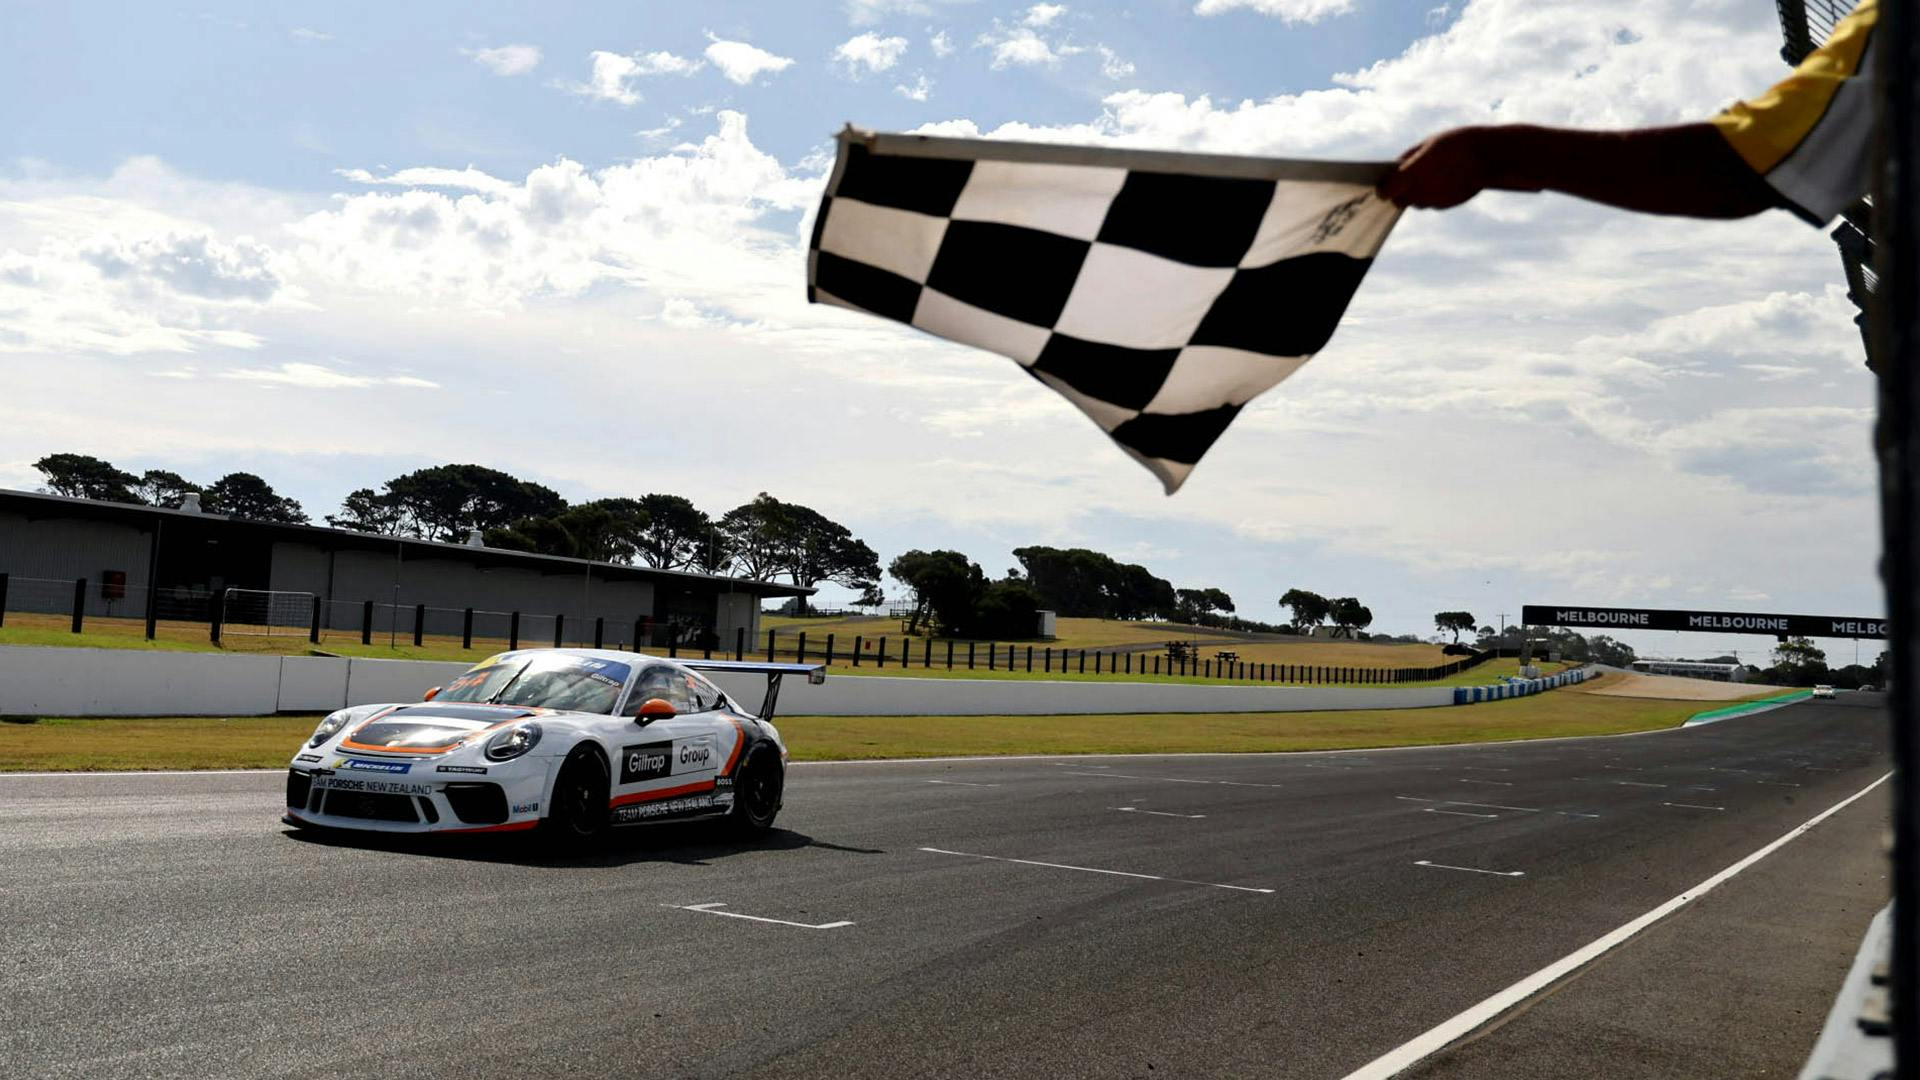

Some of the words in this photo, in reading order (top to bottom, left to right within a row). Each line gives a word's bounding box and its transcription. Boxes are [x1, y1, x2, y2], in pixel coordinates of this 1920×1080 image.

[1556, 610, 1649, 625] MELBOURNE
[1689, 615, 1788, 631] MELBOURNE
[628, 752, 665, 773] Giltrap
[680, 745, 710, 766] Group
[327, 778, 365, 791] PORSCHE
[366, 781, 387, 793] NEW
[388, 782, 432, 795] ZEALAND
[512, 803, 532, 814] Mobil
[638, 802, 669, 818] PORSCHE
